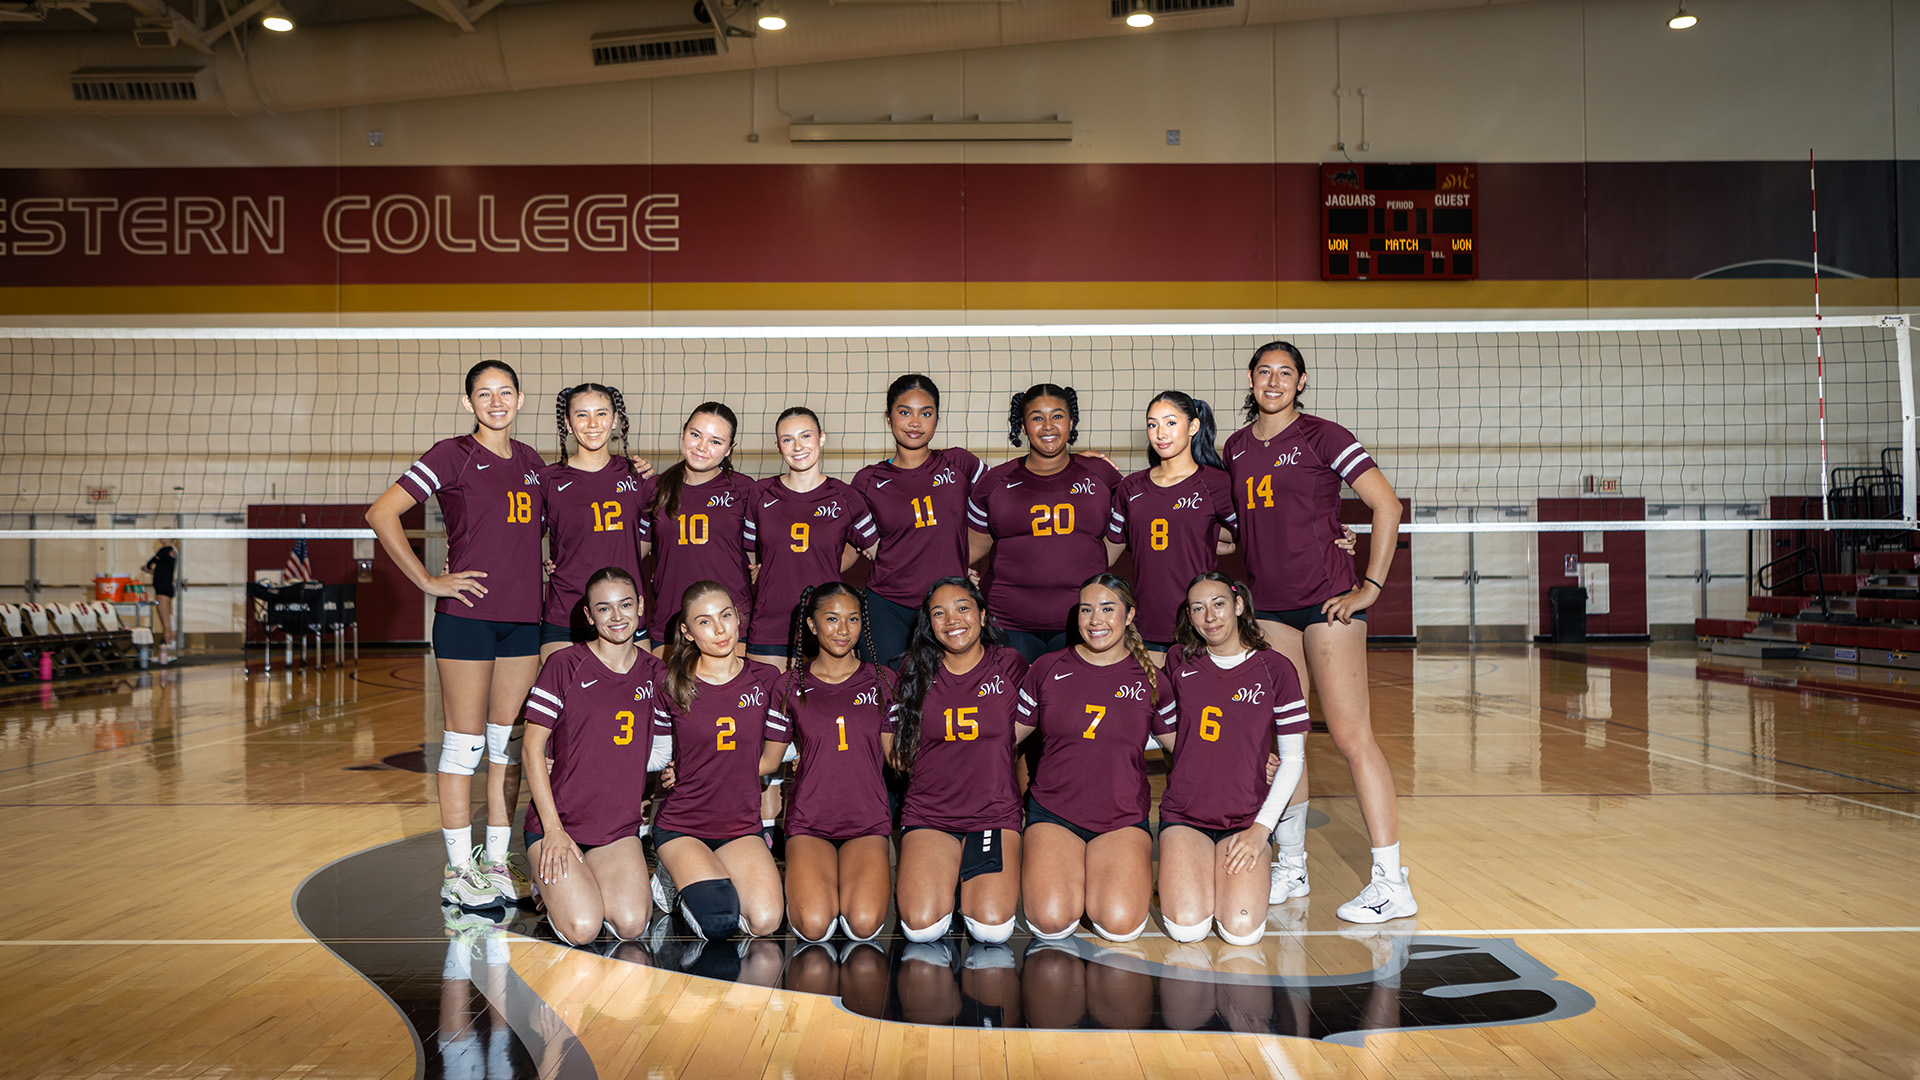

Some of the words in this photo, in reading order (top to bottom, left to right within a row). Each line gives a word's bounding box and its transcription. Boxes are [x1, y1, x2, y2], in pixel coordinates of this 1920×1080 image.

[1325, 194, 1376, 207] JAGUARS
[1386, 200, 1414, 210] PERIOD
[1434, 194, 1471, 207] GUEST
[0, 196, 284, 256] STERN
[322, 194, 680, 254] COLLEGE
[1328, 238, 1349, 251] WON
[1385, 238, 1419, 251] MATCH
[1452, 238, 1472, 251] WON
[1246, 474, 1274, 509] 14
[1602, 480, 1617, 491] EXIT
[507, 491, 531, 523] 18
[591, 501, 623, 532] 12
[911, 496, 937, 528] 11
[1031, 504, 1075, 536] 20
[678, 514, 709, 545] 10
[791, 522, 810, 552] 9
[1151, 518, 1169, 550] 8
[634, 680, 654, 701] SW
[613, 710, 635, 745] 3
[716, 716, 736, 751] 2
[836, 716, 849, 751] 1
[944, 706, 979, 741] 15
[1083, 704, 1106, 740] 7
[1200, 706, 1223, 742] 6
